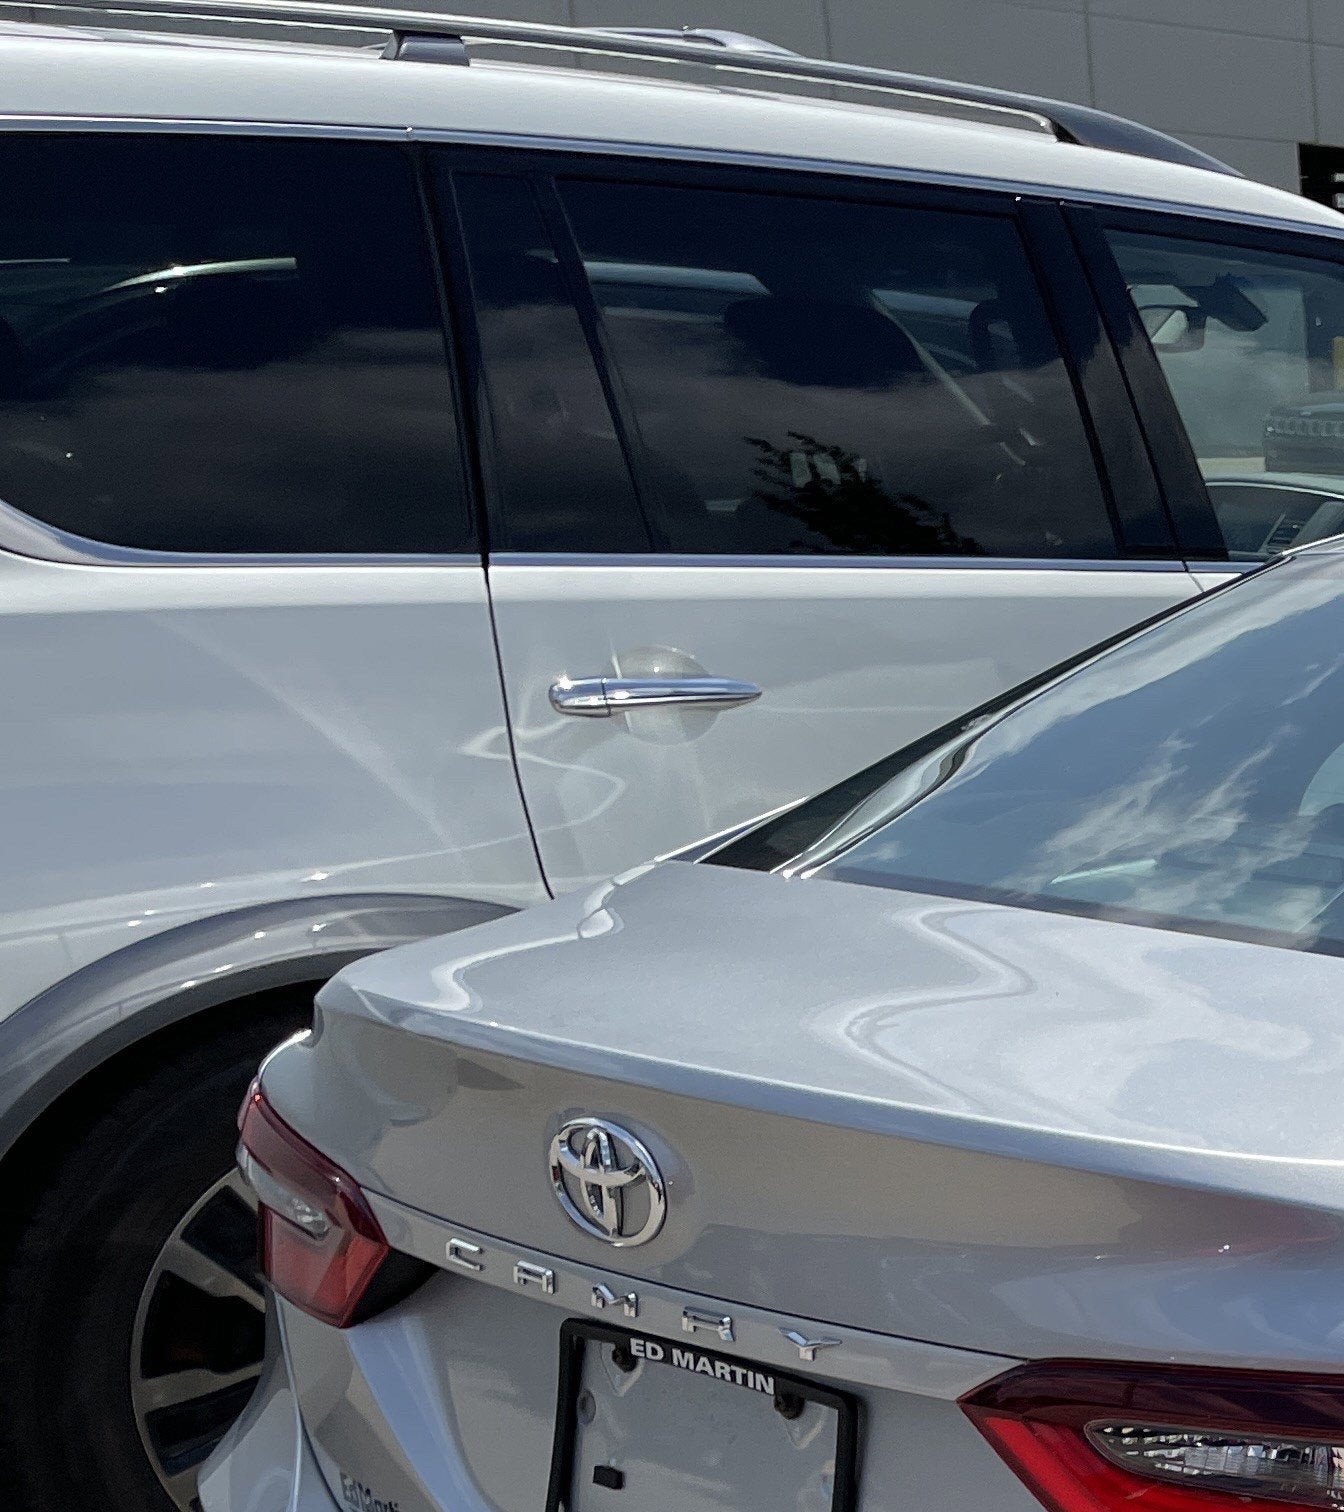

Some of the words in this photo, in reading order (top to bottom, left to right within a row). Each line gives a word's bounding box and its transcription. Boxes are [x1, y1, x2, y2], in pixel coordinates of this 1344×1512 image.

[445, 1237, 843, 1361] CAMRY
[629, 1337, 665, 1361] ED
[672, 1348, 775, 1396] MARTIN
